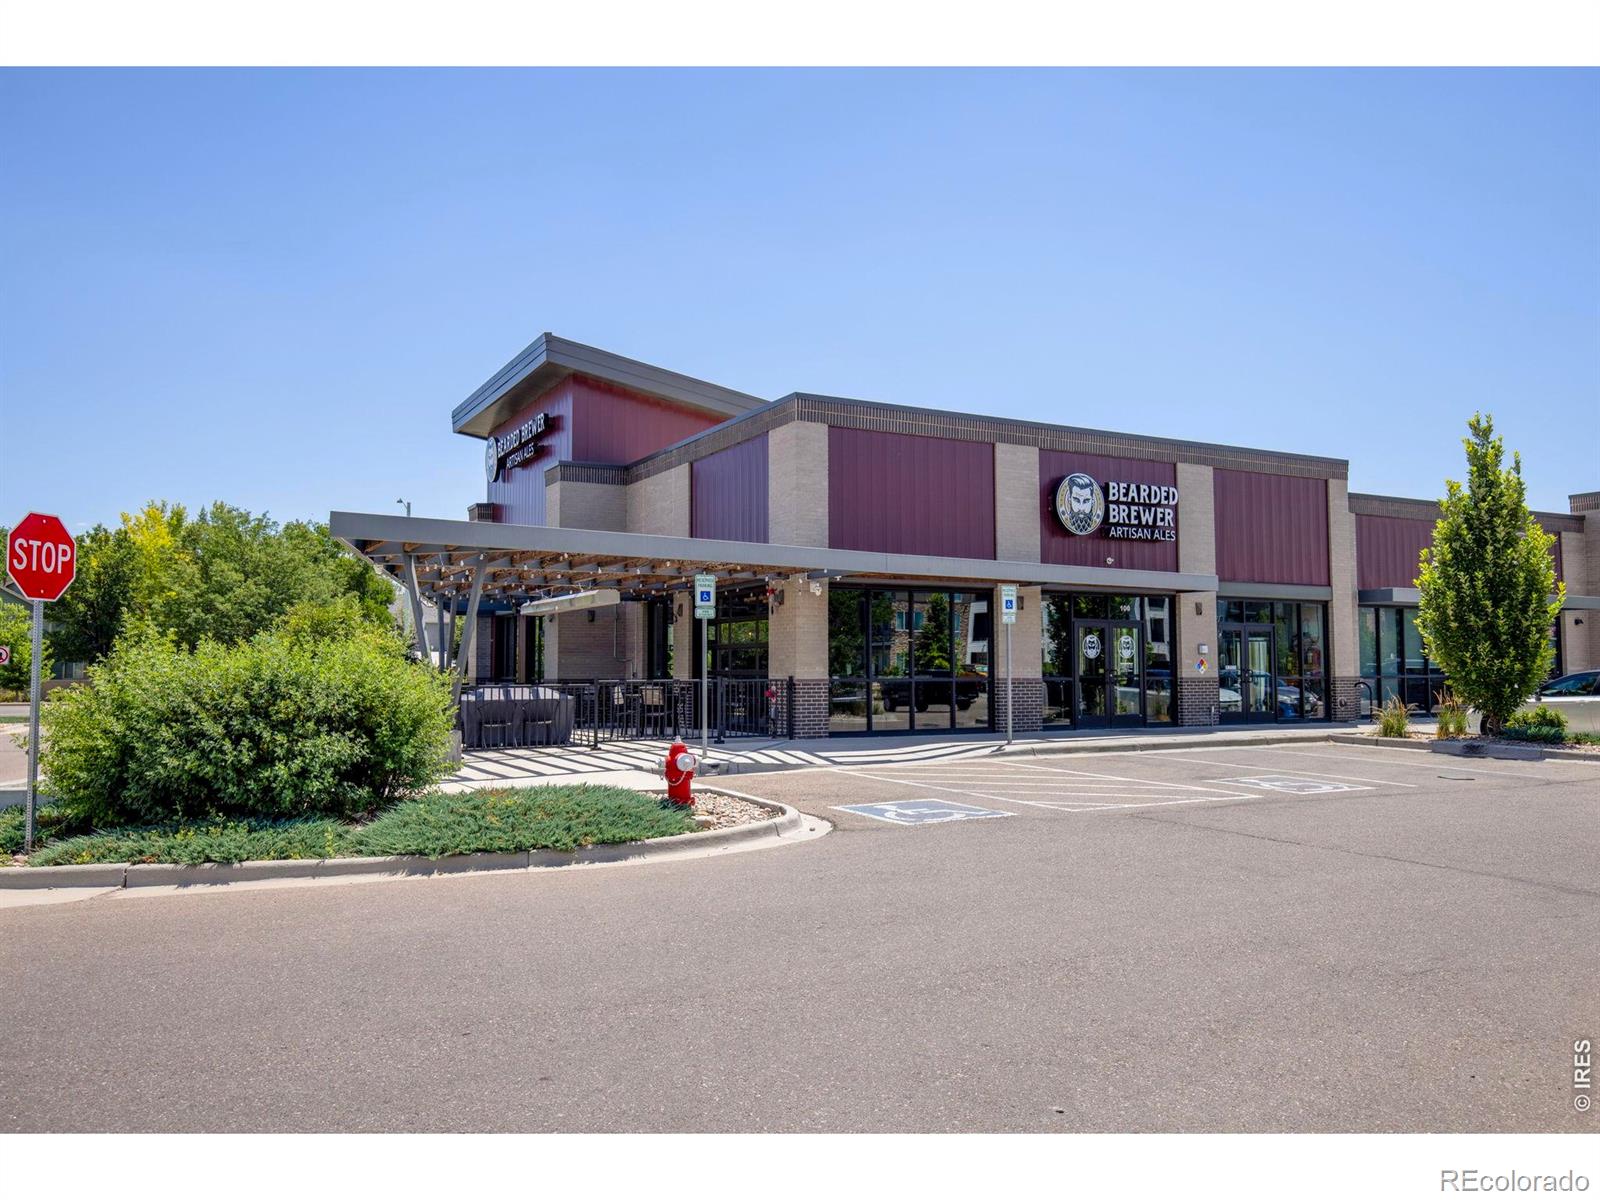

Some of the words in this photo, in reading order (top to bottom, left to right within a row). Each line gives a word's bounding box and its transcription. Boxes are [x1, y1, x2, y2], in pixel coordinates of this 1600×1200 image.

[498, 429, 520, 458] BEARDED
[521, 412, 545, 443] BREWER
[1108, 481, 1179, 506] BEARDED
[1108, 503, 1175, 528] BREWER
[1109, 526, 1151, 540] ARTISAN
[1153, 529, 1176, 542] ALES
[12, 537, 72, 575] STOP
